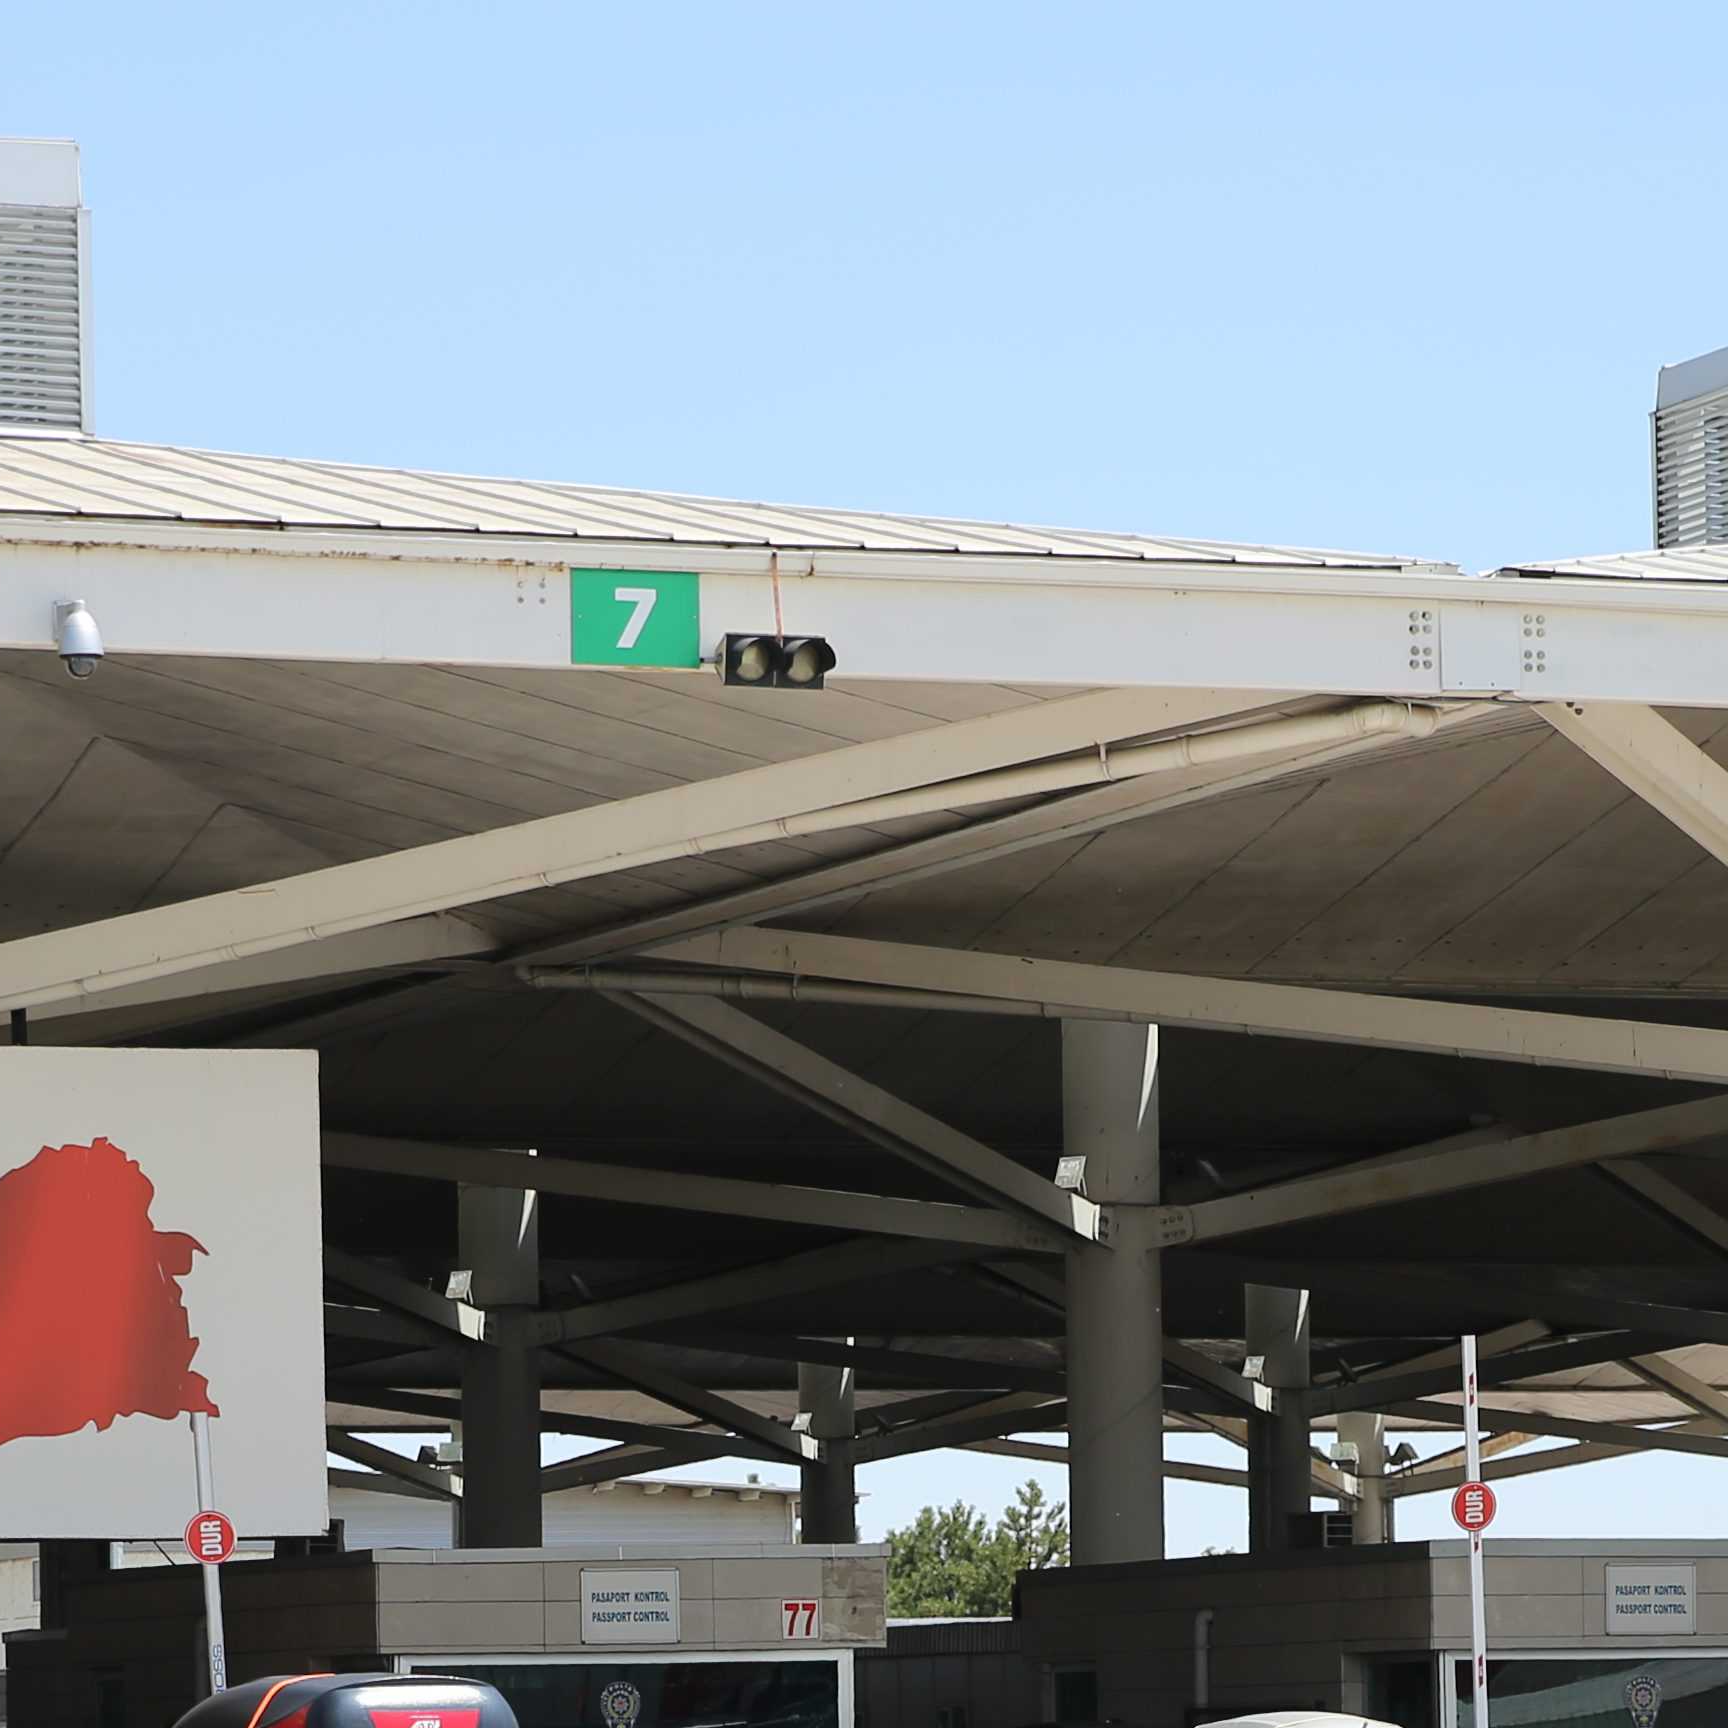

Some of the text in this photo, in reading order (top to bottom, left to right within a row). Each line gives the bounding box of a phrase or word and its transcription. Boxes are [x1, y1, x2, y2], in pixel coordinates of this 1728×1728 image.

[614, 587, 657, 649] 7
[1465, 1490, 1483, 1523] DUR
[200, 1521, 223, 1556] DUR
[591, 1591, 670, 1603] PASAPORT KONTROL
[1615, 1585, 1687, 1596] PASAPORT KONTROL
[591, 1611, 670, 1622] PASSPORT CONTROL
[784, 1603, 817, 1637] 77
[1615, 1604, 1687, 1614] PASSPORT CONTROL
